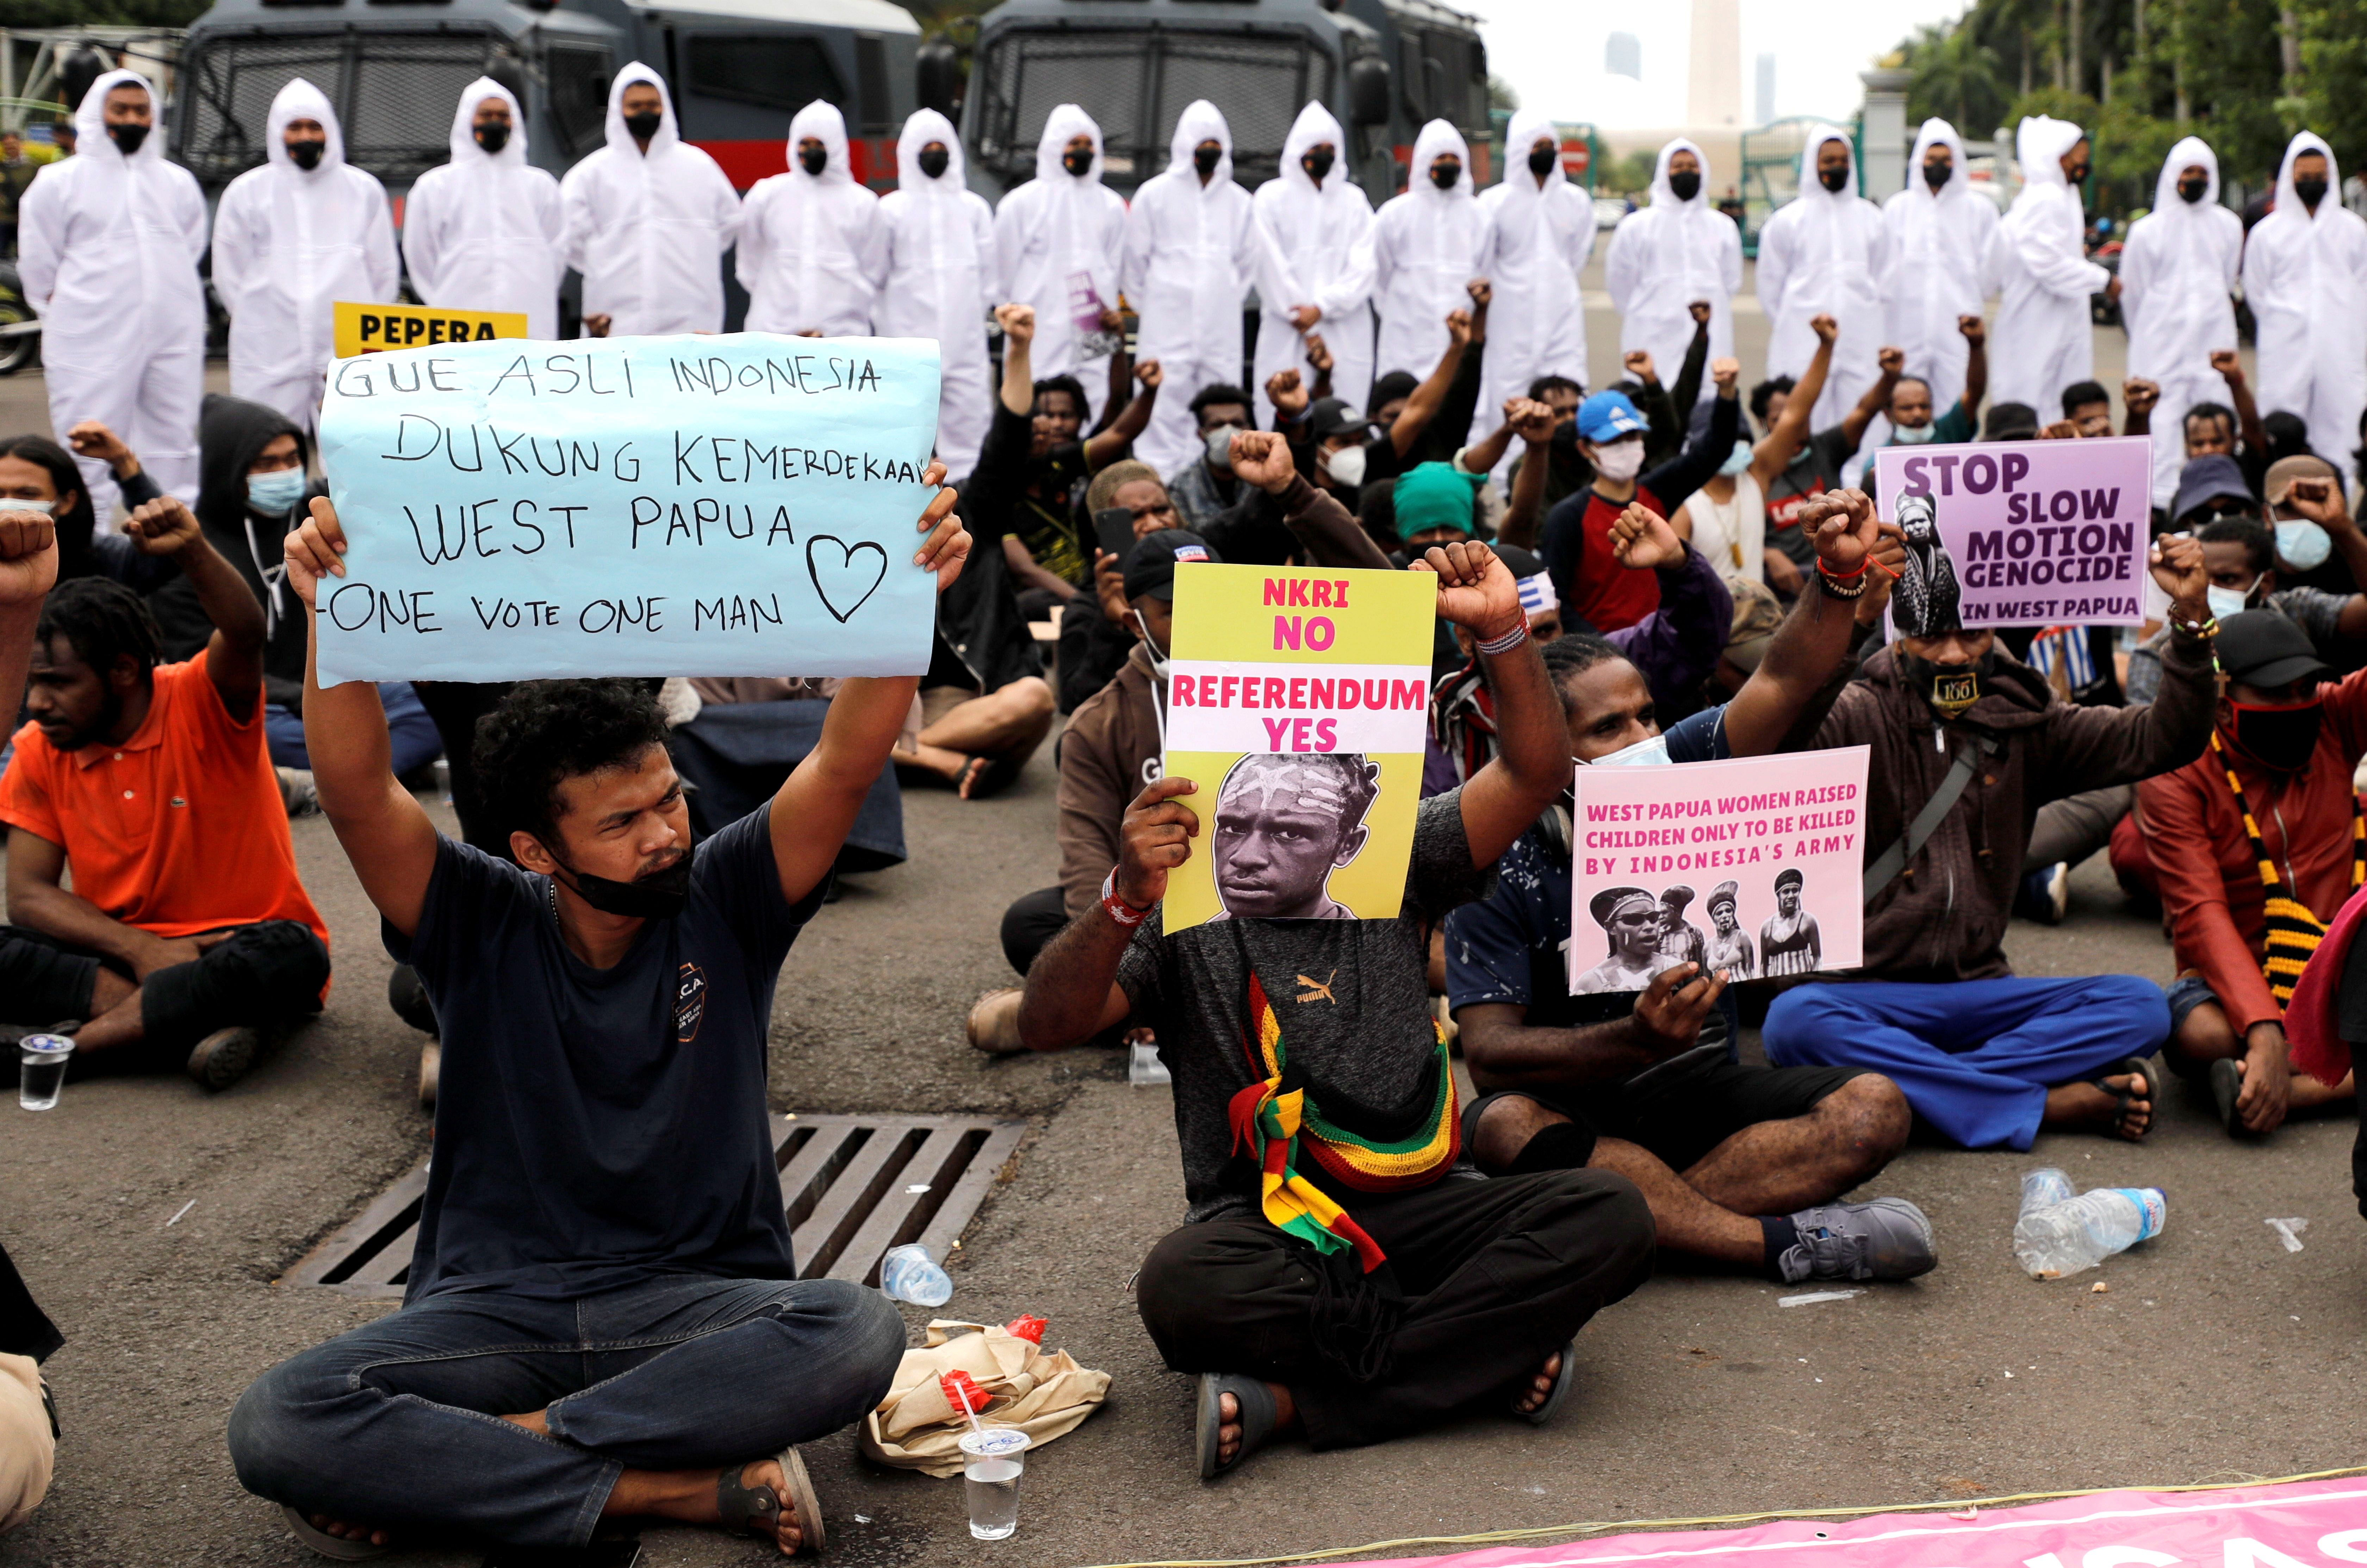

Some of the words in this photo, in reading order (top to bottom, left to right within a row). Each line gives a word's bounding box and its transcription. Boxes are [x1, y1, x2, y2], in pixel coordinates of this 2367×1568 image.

[361, 315, 495, 345] PEPERA
[335, 359, 463, 397] GUE
[670, 356, 882, 395] INDONESIA
[381, 414, 639, 482] DUKUNG
[1904, 453, 2029, 497] STOP
[2007, 487, 2120, 525] SLOW
[403, 499, 588, 565] WEST
[631, 496, 794, 549] PAPUA
[1967, 523, 2134, 562] MOTION
[1965, 555, 2131, 588] GENOCIDE
[1264, 579, 1349, 607] NKRI
[1963, 604, 1989, 619] IN
[1997, 601, 2058, 618] WEST
[2063, 598, 2138, 616] PAPUA
[471, 596, 560, 630] VOTE
[579, 596, 666, 633] ONE
[695, 593, 783, 633] MAN
[1274, 616, 1335, 651] NO
[1173, 675, 1425, 711] REFERENDUM
[1262, 718, 1337, 752] YES
[1588, 805, 1644, 821] WEST
[1649, 800, 1712, 820] PAPUA
[1718, 792, 1790, 814] WOMEN
[1795, 784, 1856, 806] RAISED
[1586, 828, 1684, 848] CHILDREN
[1691, 823, 1739, 843] ONLY
[1745, 820, 1767, 837] TO
[1774, 817, 1793, 834] BE
[1800, 810, 1855, 831] KILLED
[1586, 858, 1616, 874] BY
[1795, 834, 1854, 856] ARMY
